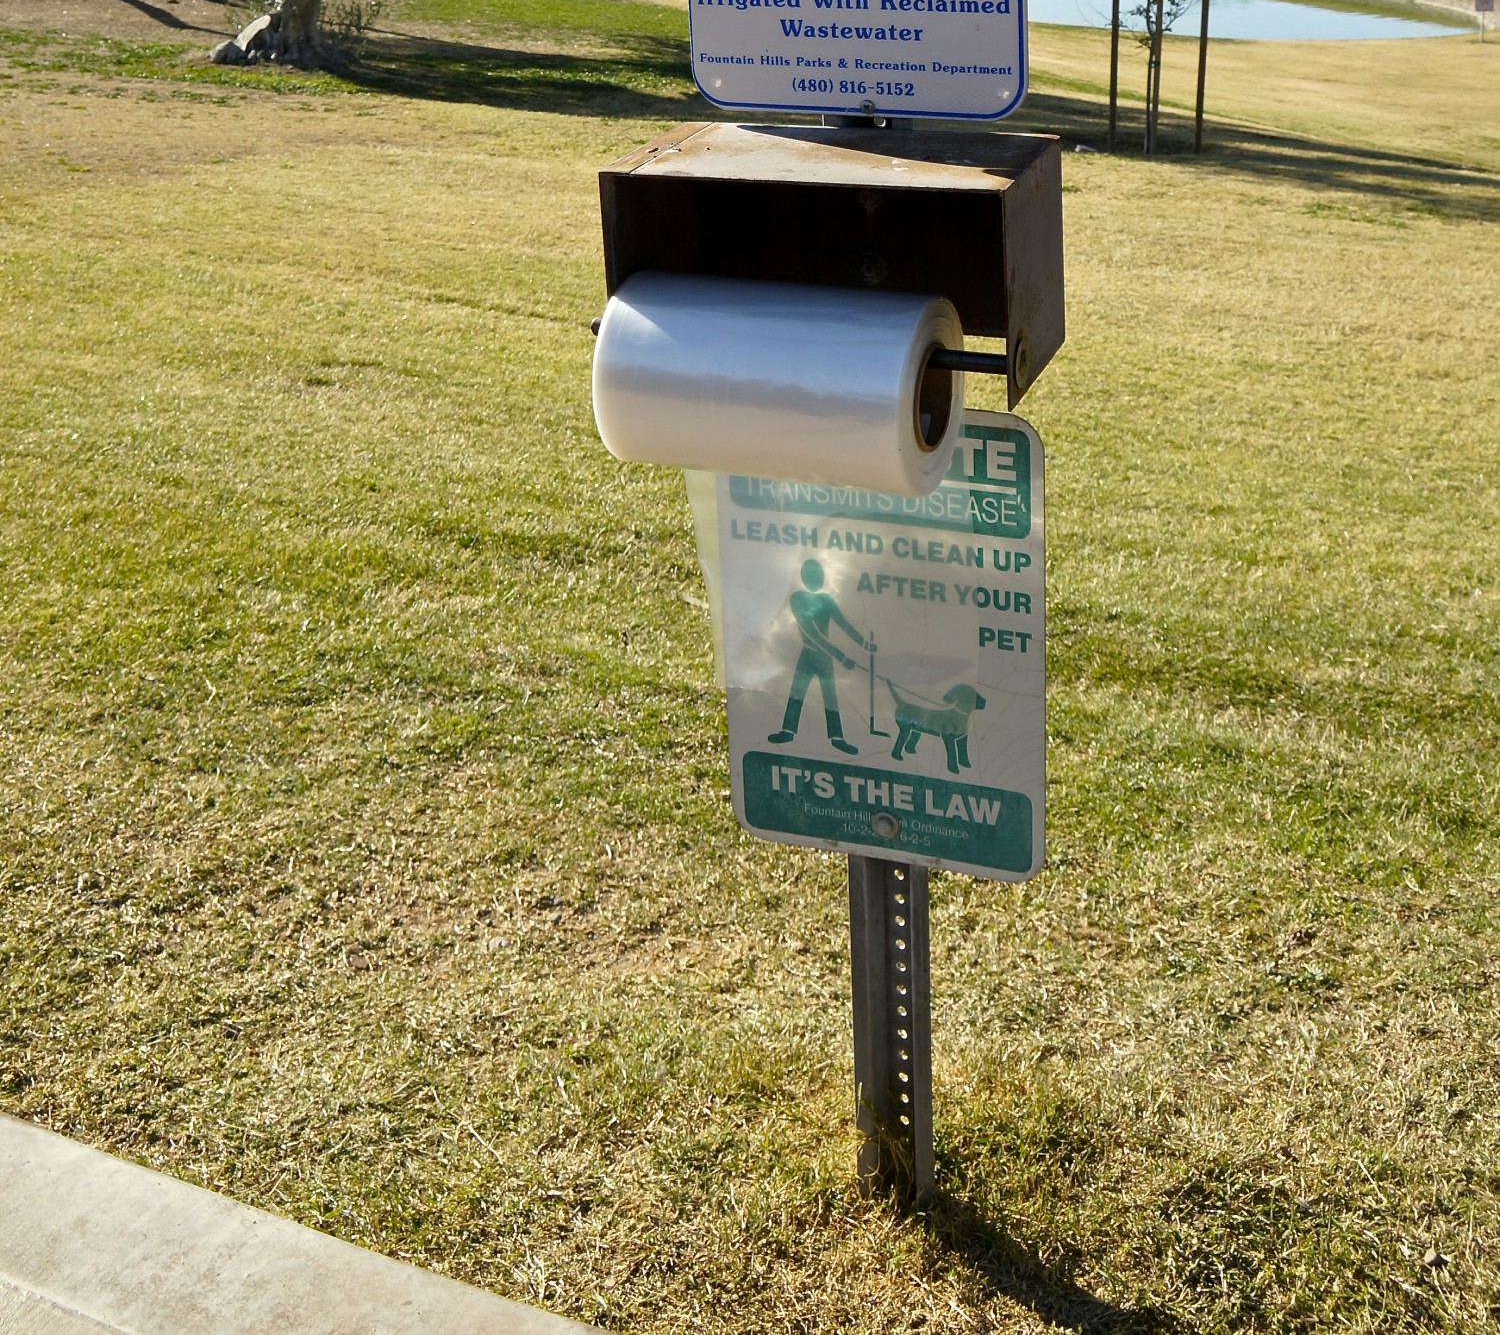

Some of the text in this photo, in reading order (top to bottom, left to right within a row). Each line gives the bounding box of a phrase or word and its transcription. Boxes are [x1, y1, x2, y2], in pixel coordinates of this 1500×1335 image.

[780, 18, 923, 42] Wastewater
[700, 53, 1013, 77] Fountain Hills Parks & Recreation Department
[792, 77, 915, 96] (480) 816-5152
[902, 491, 1018, 526] DISEASE
[731, 519, 1032, 574] LEASH AND CLEAN UP
[856, 572, 1032, 615] AFTER YOUR
[978, 626, 1032, 653] PET
[844, 775, 914, 812] THE
[925, 789, 1001, 826] LAW
[804, 802, 850, 820] Fountain
[854, 810, 873, 823] Hill
[911, 819, 969, 840] Ordinance
